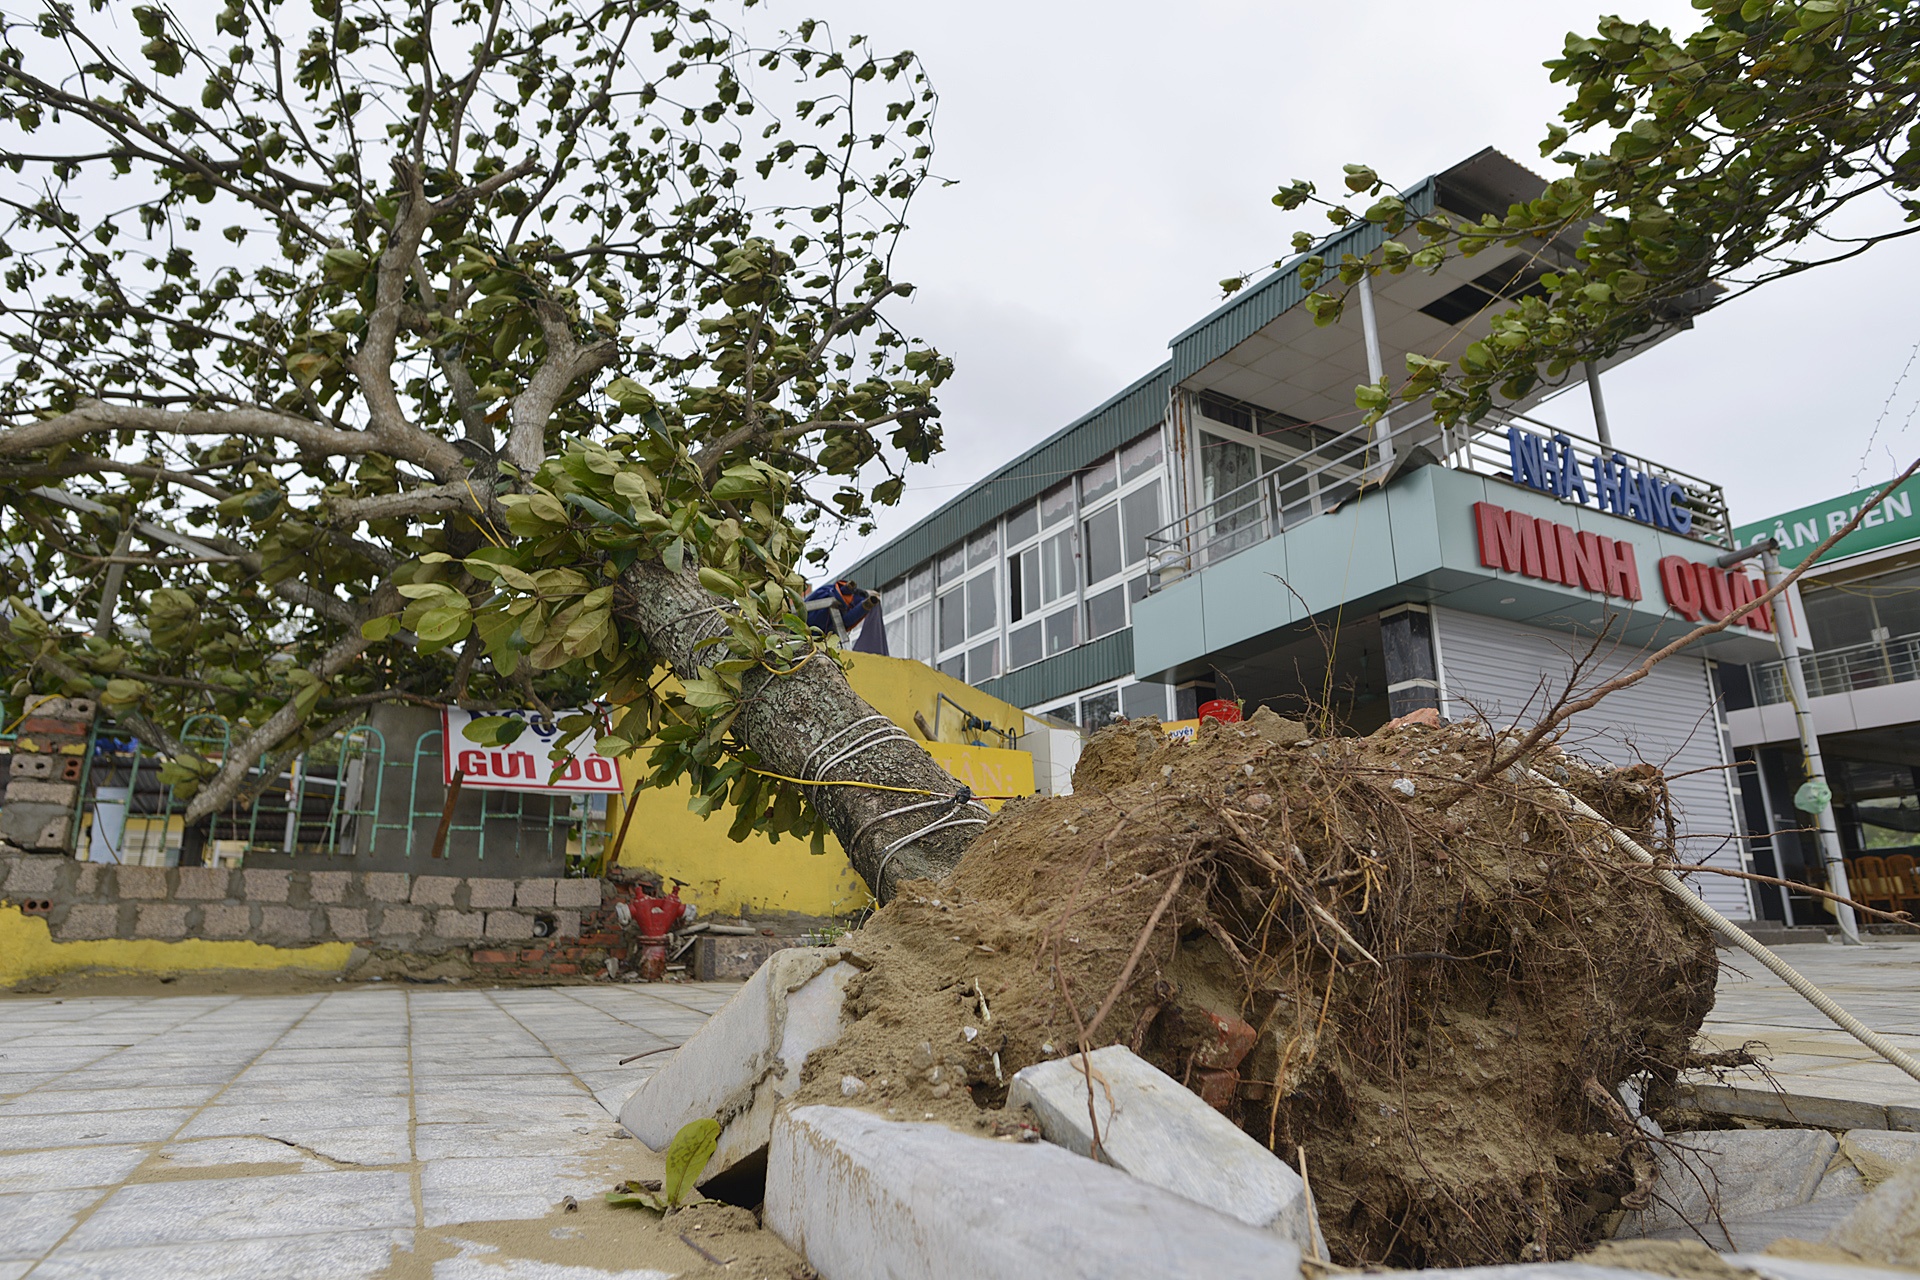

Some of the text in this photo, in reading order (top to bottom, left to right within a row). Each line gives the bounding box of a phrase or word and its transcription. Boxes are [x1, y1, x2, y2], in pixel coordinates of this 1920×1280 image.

[1508, 427, 1692, 535] NHÀ HÀNG
[1473, 501, 1643, 602] MINH
